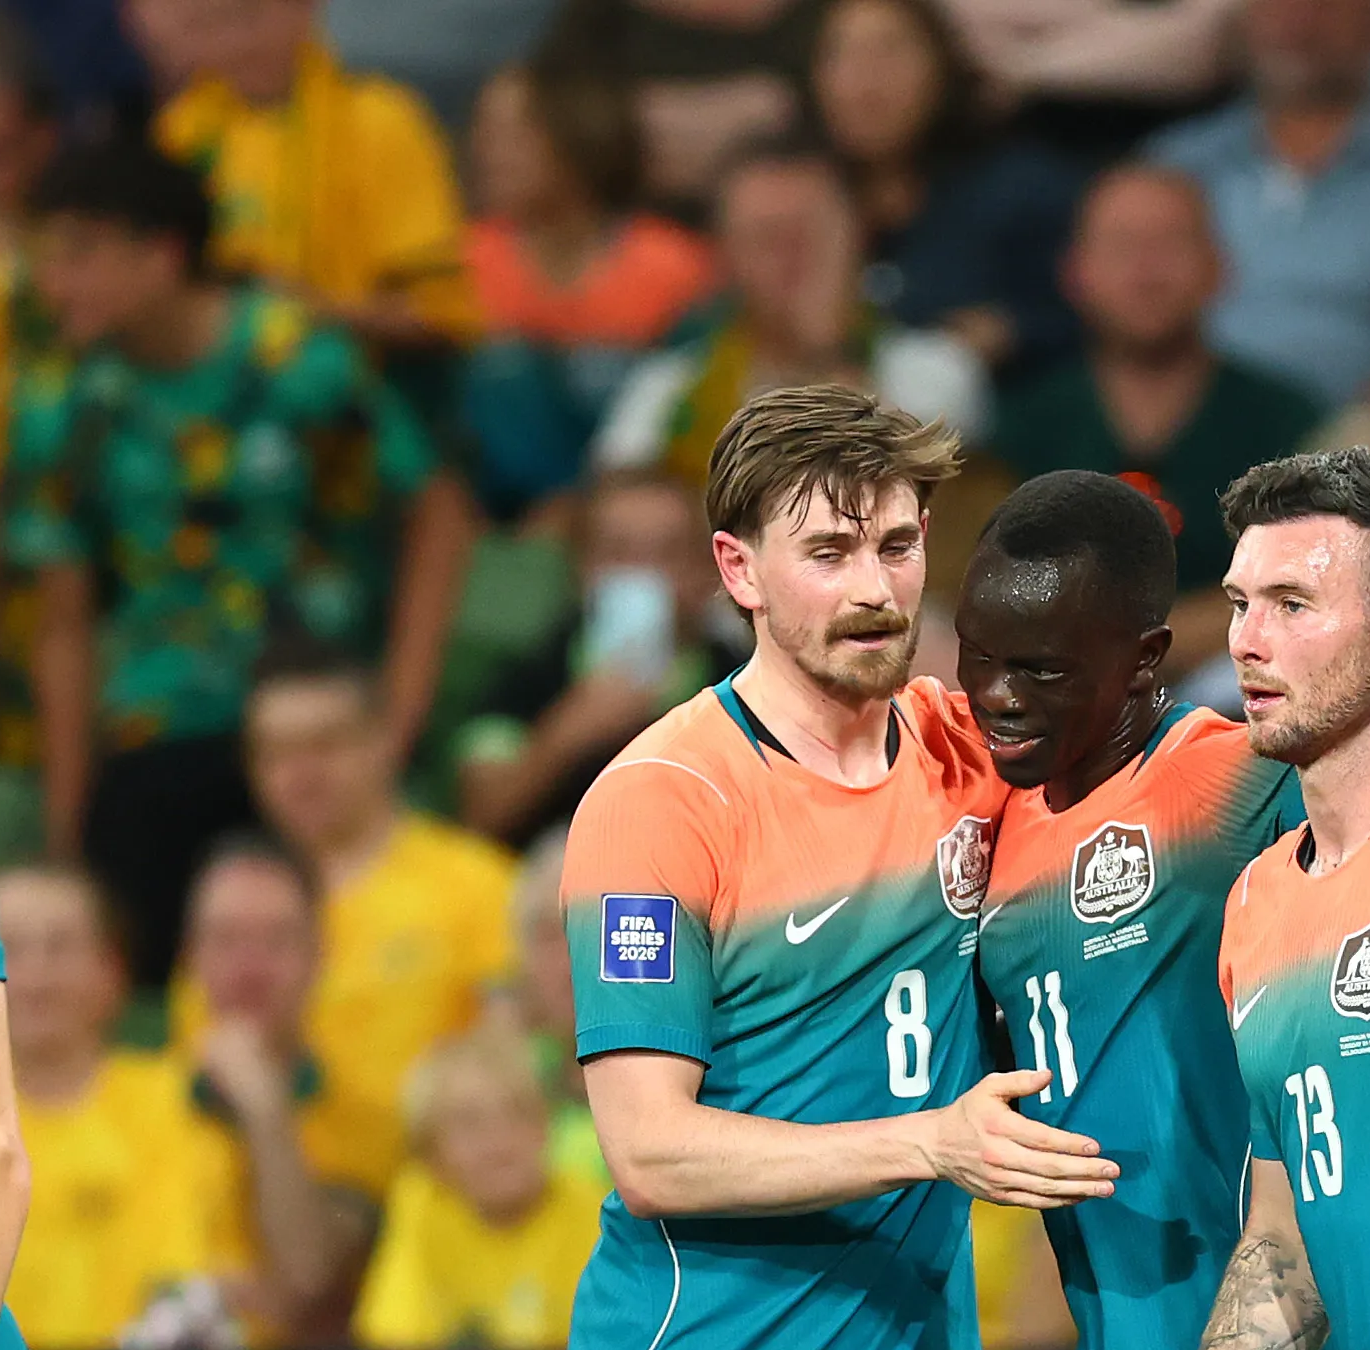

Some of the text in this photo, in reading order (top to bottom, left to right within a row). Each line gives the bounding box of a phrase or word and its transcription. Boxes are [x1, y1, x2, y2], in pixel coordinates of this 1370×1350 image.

[620, 916, 656, 930] FIFA
[1084, 877, 1138, 900] AUSTRALIA
[610, 930, 665, 946] SERIES
[884, 969, 932, 1098] 8
[1026, 970, 1079, 1104] 11
[1285, 1065, 1343, 1202] 13
